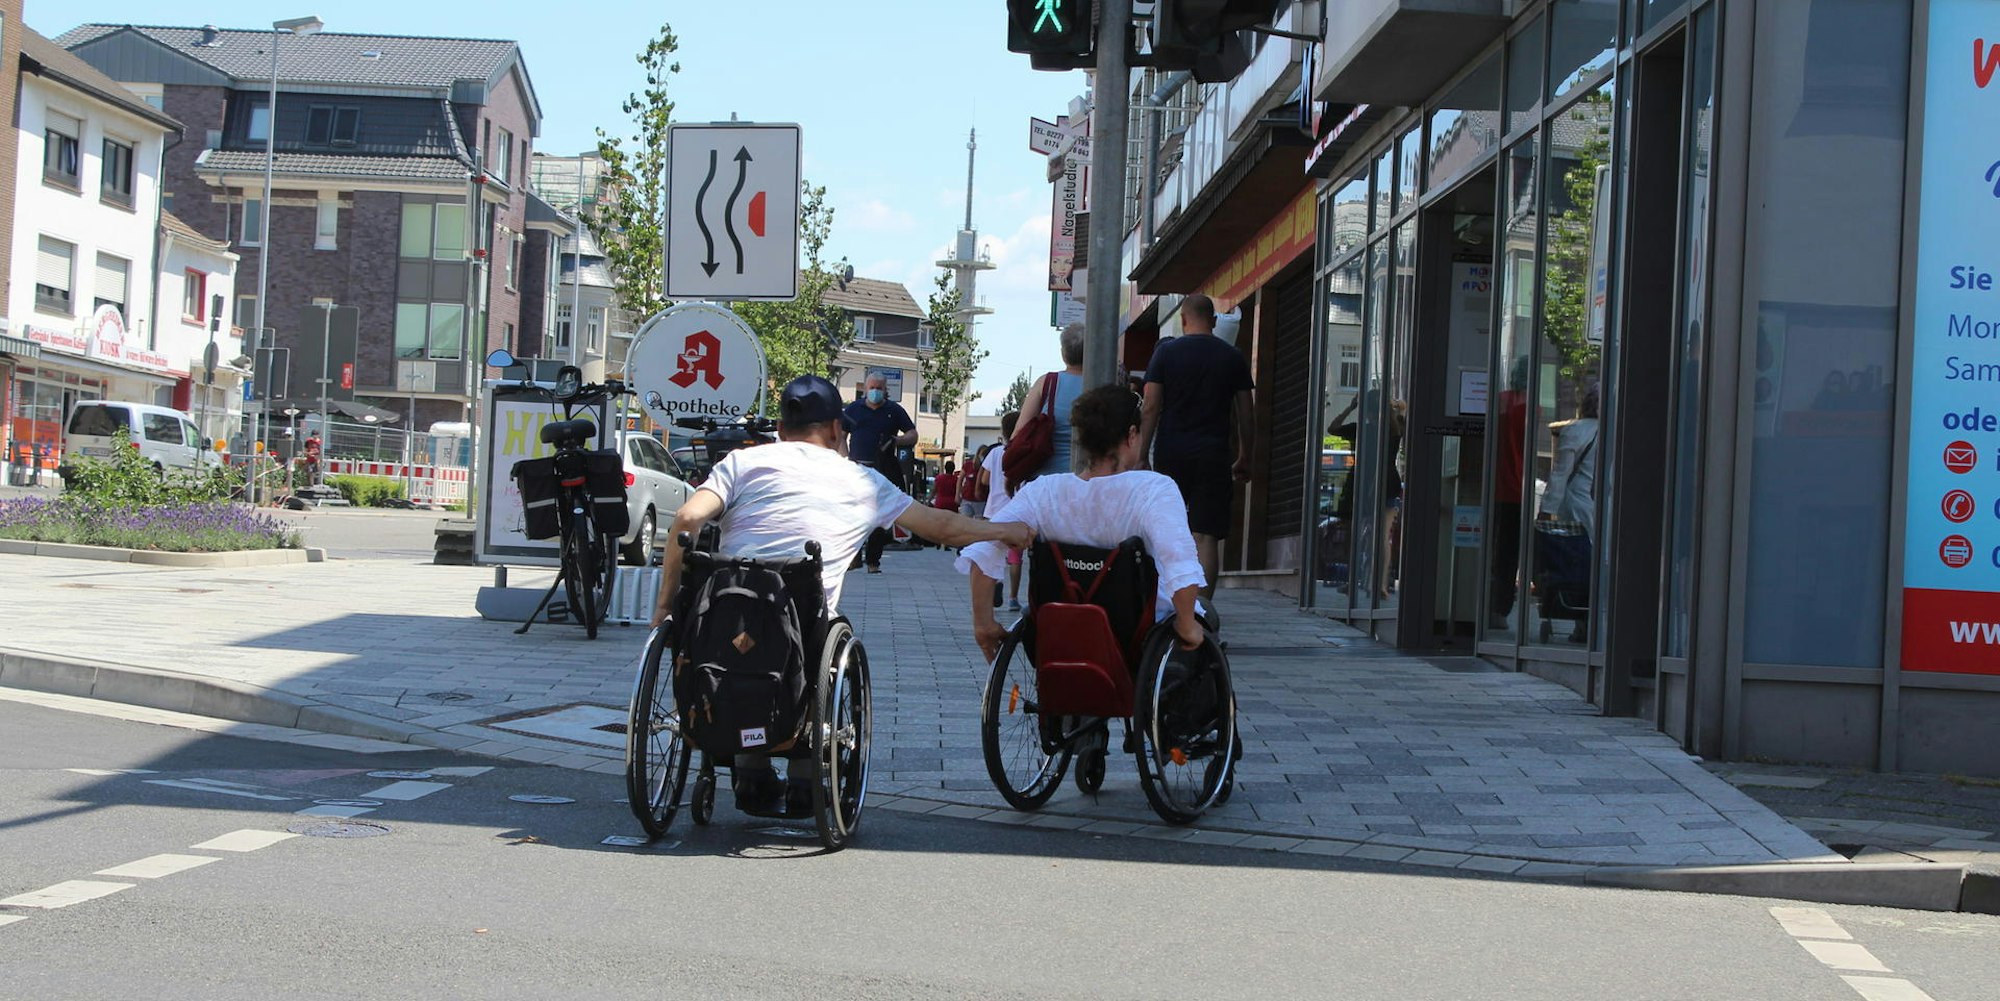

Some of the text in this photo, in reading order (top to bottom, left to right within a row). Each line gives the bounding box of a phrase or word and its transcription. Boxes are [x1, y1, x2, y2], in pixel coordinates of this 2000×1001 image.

[1950, 265, 1992, 291] Sie
[900, 449, 907, 460] P
[743, 733, 764, 742] FILA
